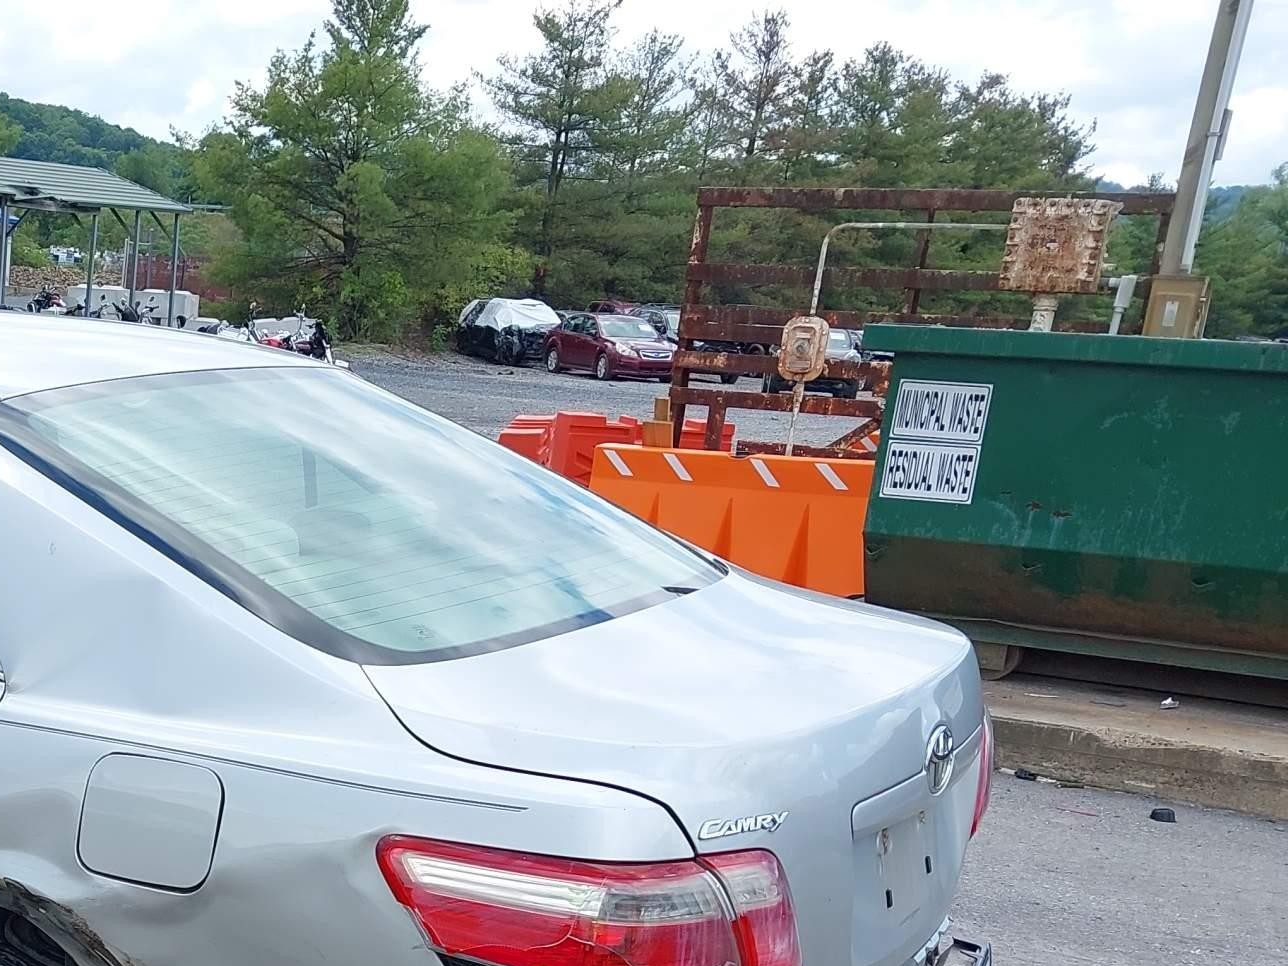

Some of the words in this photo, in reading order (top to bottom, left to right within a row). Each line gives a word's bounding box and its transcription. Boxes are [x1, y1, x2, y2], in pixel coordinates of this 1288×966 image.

[895, 388, 949, 431] MUNICIPAL
[948, 392, 985, 434] WASTE
[886, 449, 935, 492] RESIDUAL
[935, 453, 974, 495] WASTE
[698, 810, 789, 840] CAMRY
